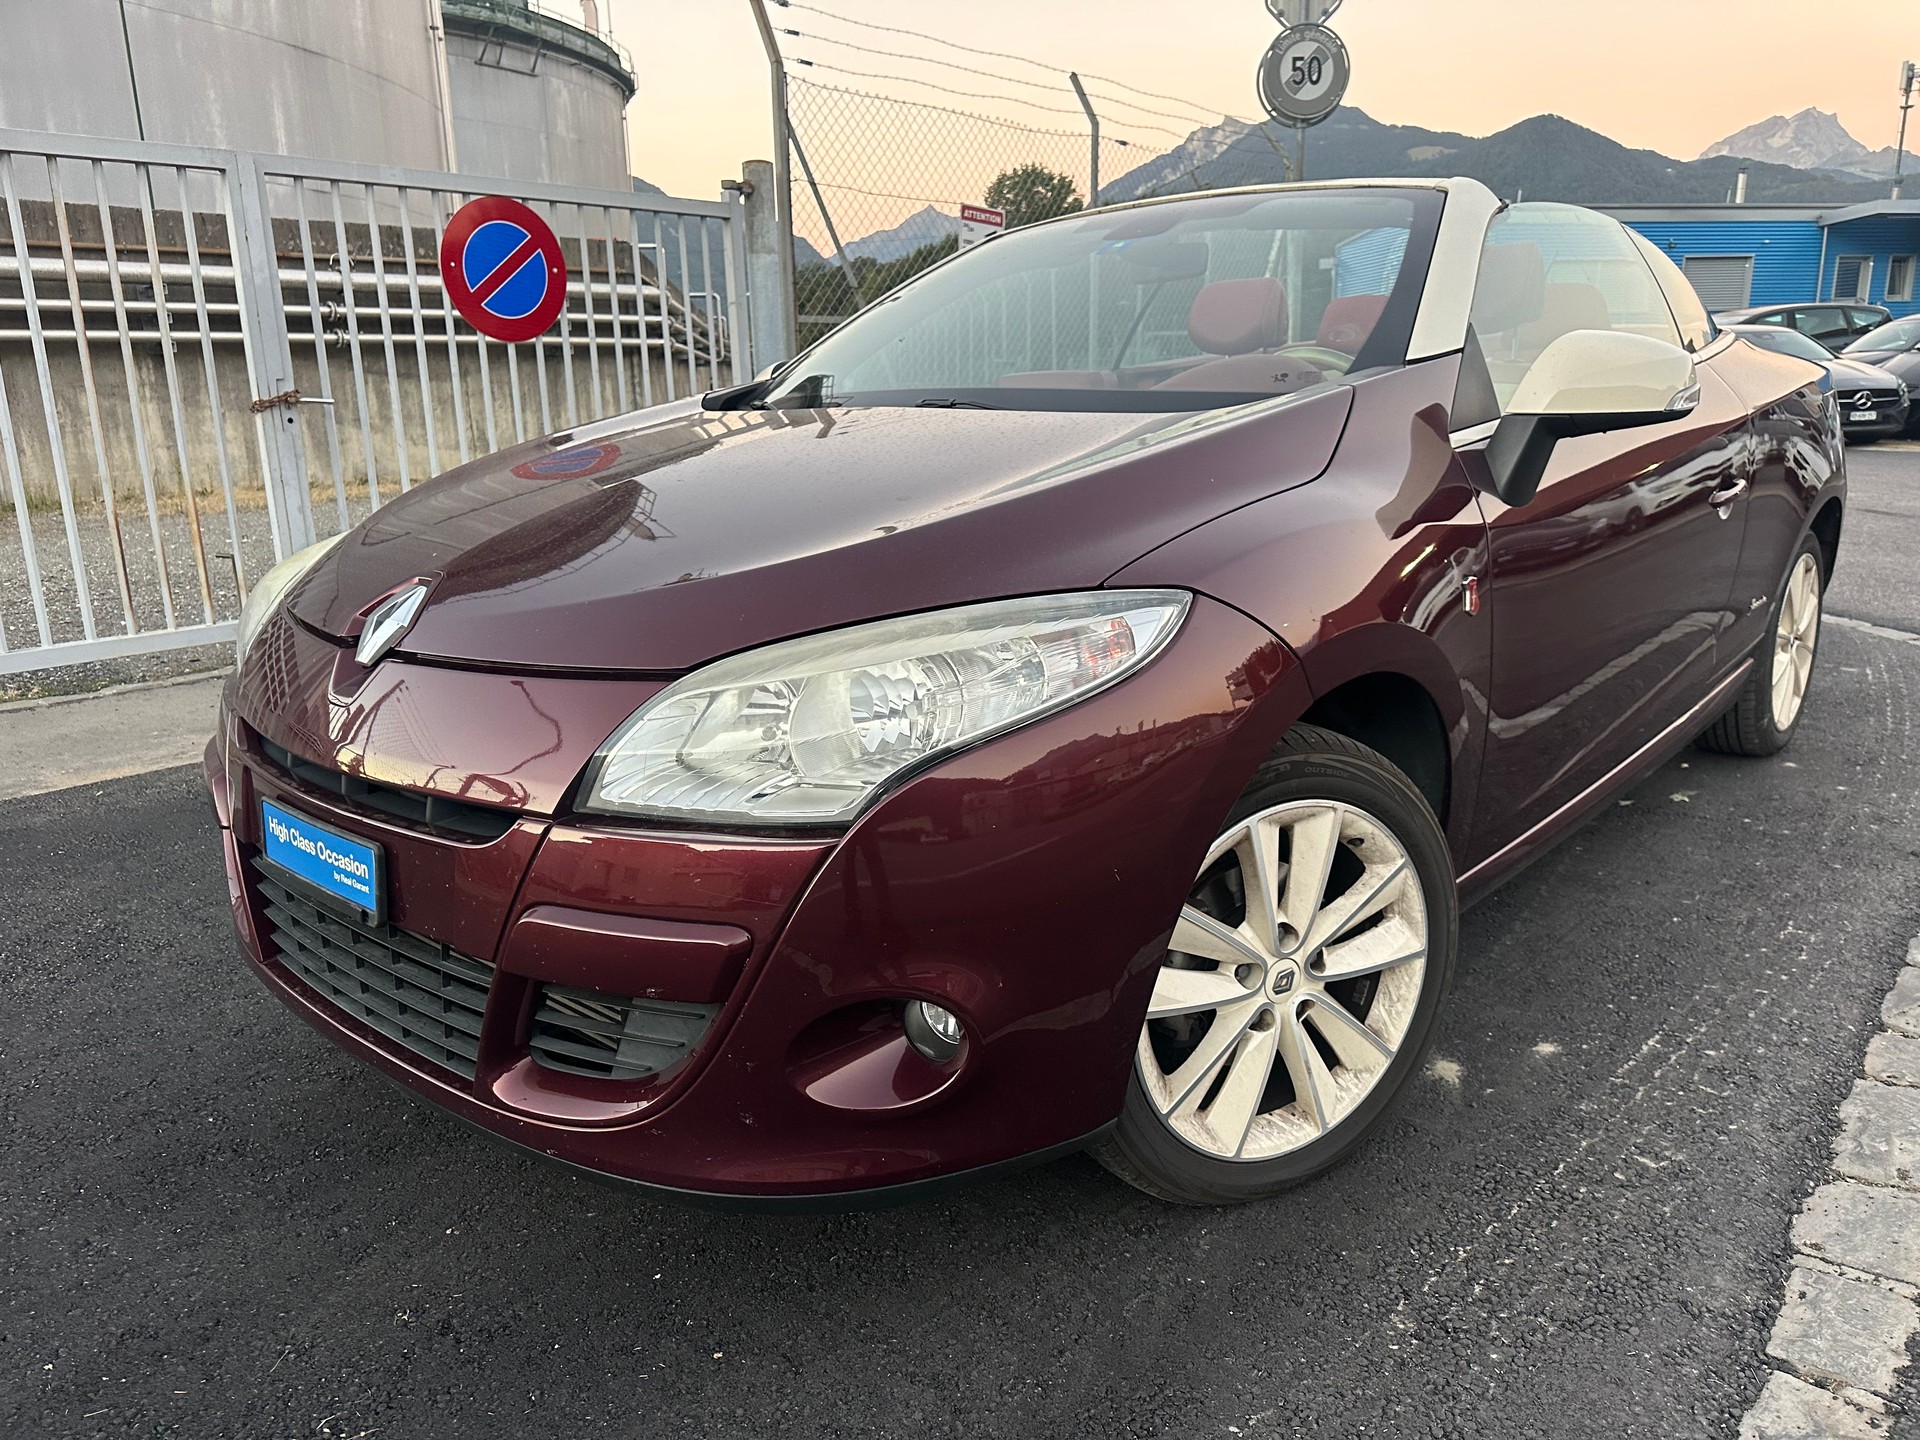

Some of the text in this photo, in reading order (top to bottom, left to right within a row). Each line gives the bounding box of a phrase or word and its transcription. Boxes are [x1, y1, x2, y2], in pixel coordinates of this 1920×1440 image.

[1292, 56, 1321, 85] 50
[963, 209, 1002, 224] ATTENTION
[1304, 766, 1350, 778] OUTSIDE
[268, 816, 369, 879] High Class Occasion
[333, 870, 370, 894] by Real Garant
